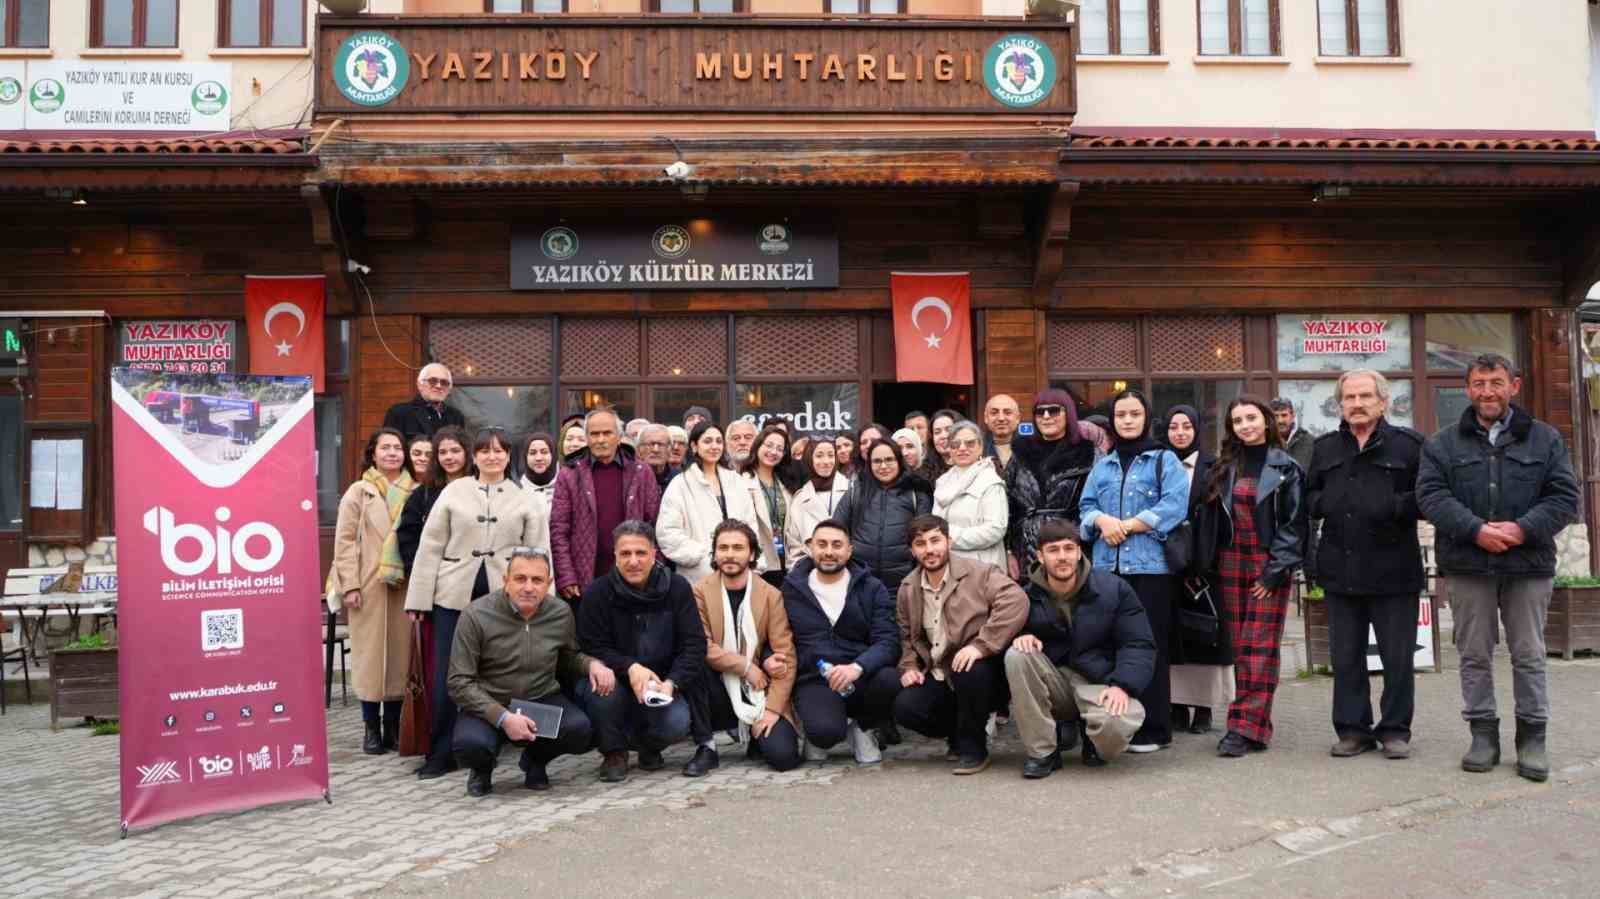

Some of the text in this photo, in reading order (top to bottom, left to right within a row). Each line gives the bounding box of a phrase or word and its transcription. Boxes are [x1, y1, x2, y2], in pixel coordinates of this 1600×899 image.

[413, 48, 973, 81] YAZIKÖY MUHTARLIĞI
[65, 69, 101, 84] YAZIKÖY
[130, 72, 148, 85] KUR
[150, 73, 162, 86] AN
[165, 73, 193, 87] KURSU
[122, 91, 135, 105] VE
[114, 110, 151, 124] KORUMA
[532, 259, 814, 283] YAZIKÖY KÜLTÜR MERKEZİ
[124, 341, 231, 360] MUHTARLIĞI
[1304, 338, 1386, 352] MUHTARLIĞI
[159, 505, 284, 576] bio
[169, 681, 277, 701] www.karabuk.edu.tr
